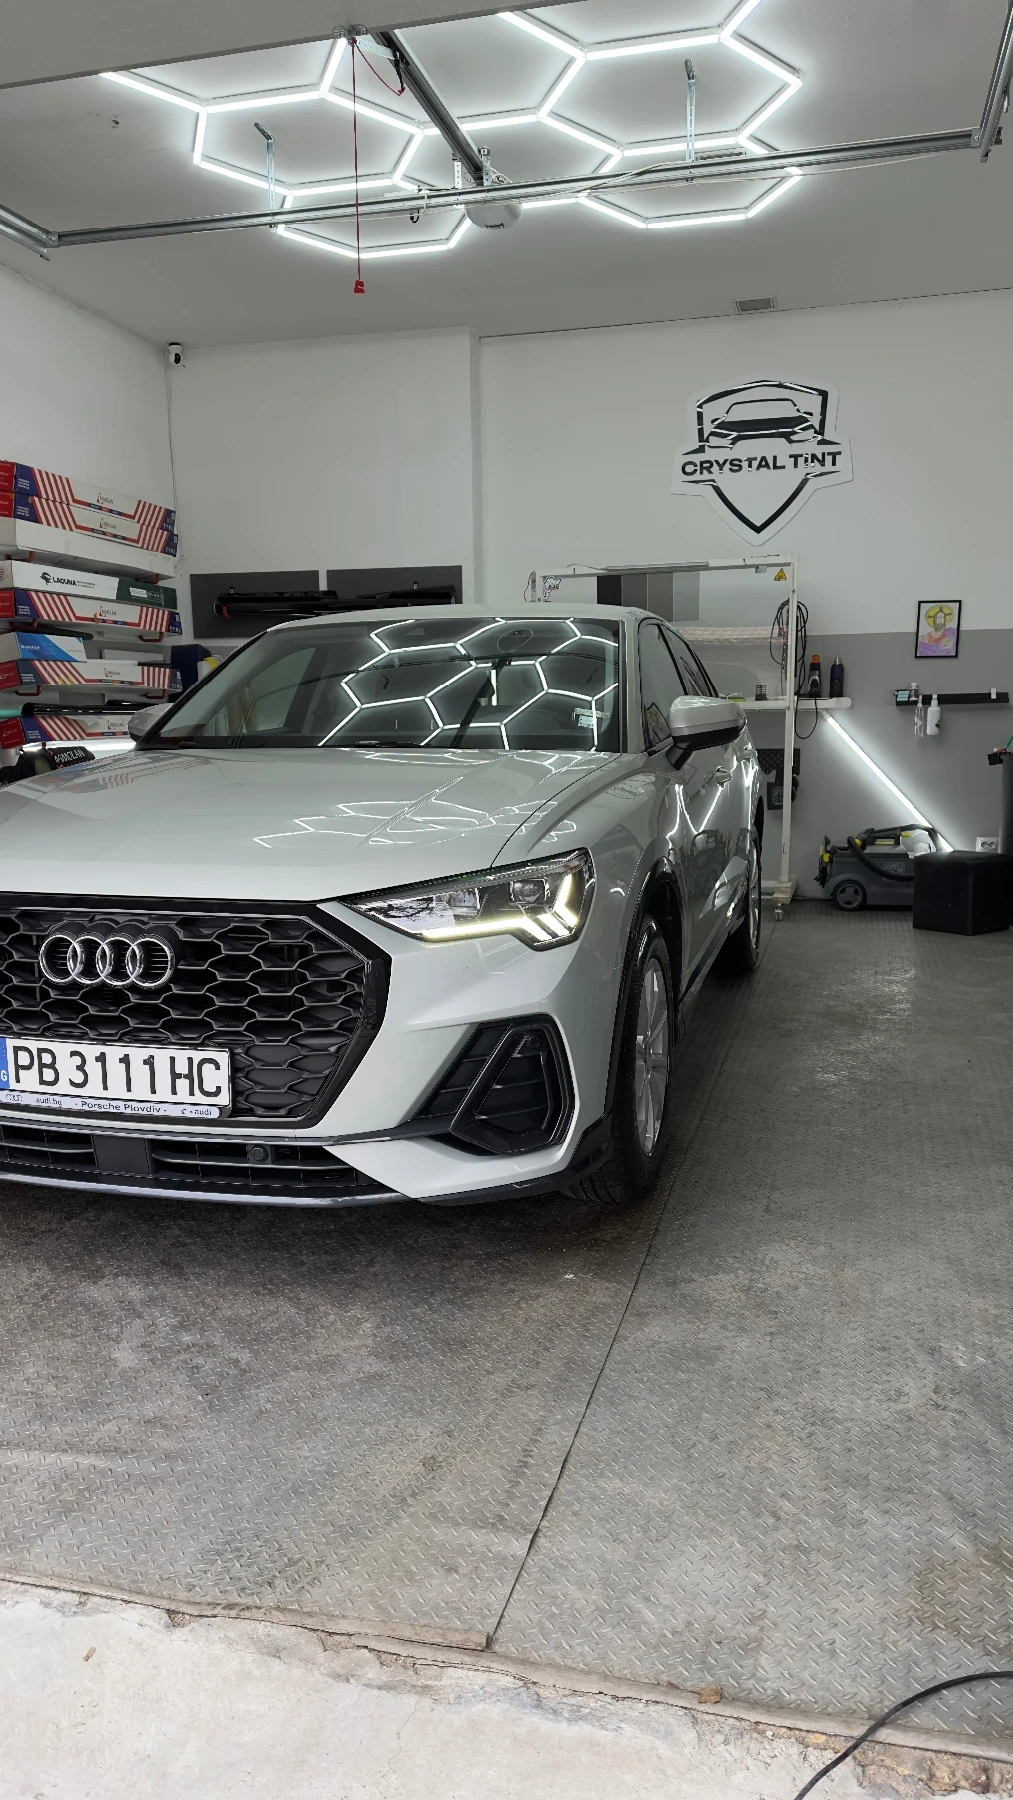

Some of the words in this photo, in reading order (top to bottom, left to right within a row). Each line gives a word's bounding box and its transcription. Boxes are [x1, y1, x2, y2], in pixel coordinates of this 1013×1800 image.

[681, 455, 786, 477] CRYSTAL
[789, 451, 843, 469] TINT
[0, 1069, 8, 1082] G
[68, 1050, 157, 1095] 3111
[81, 1101, 121, 1111] Porsche
[124, 1103, 161, 1113] Plovdiv
